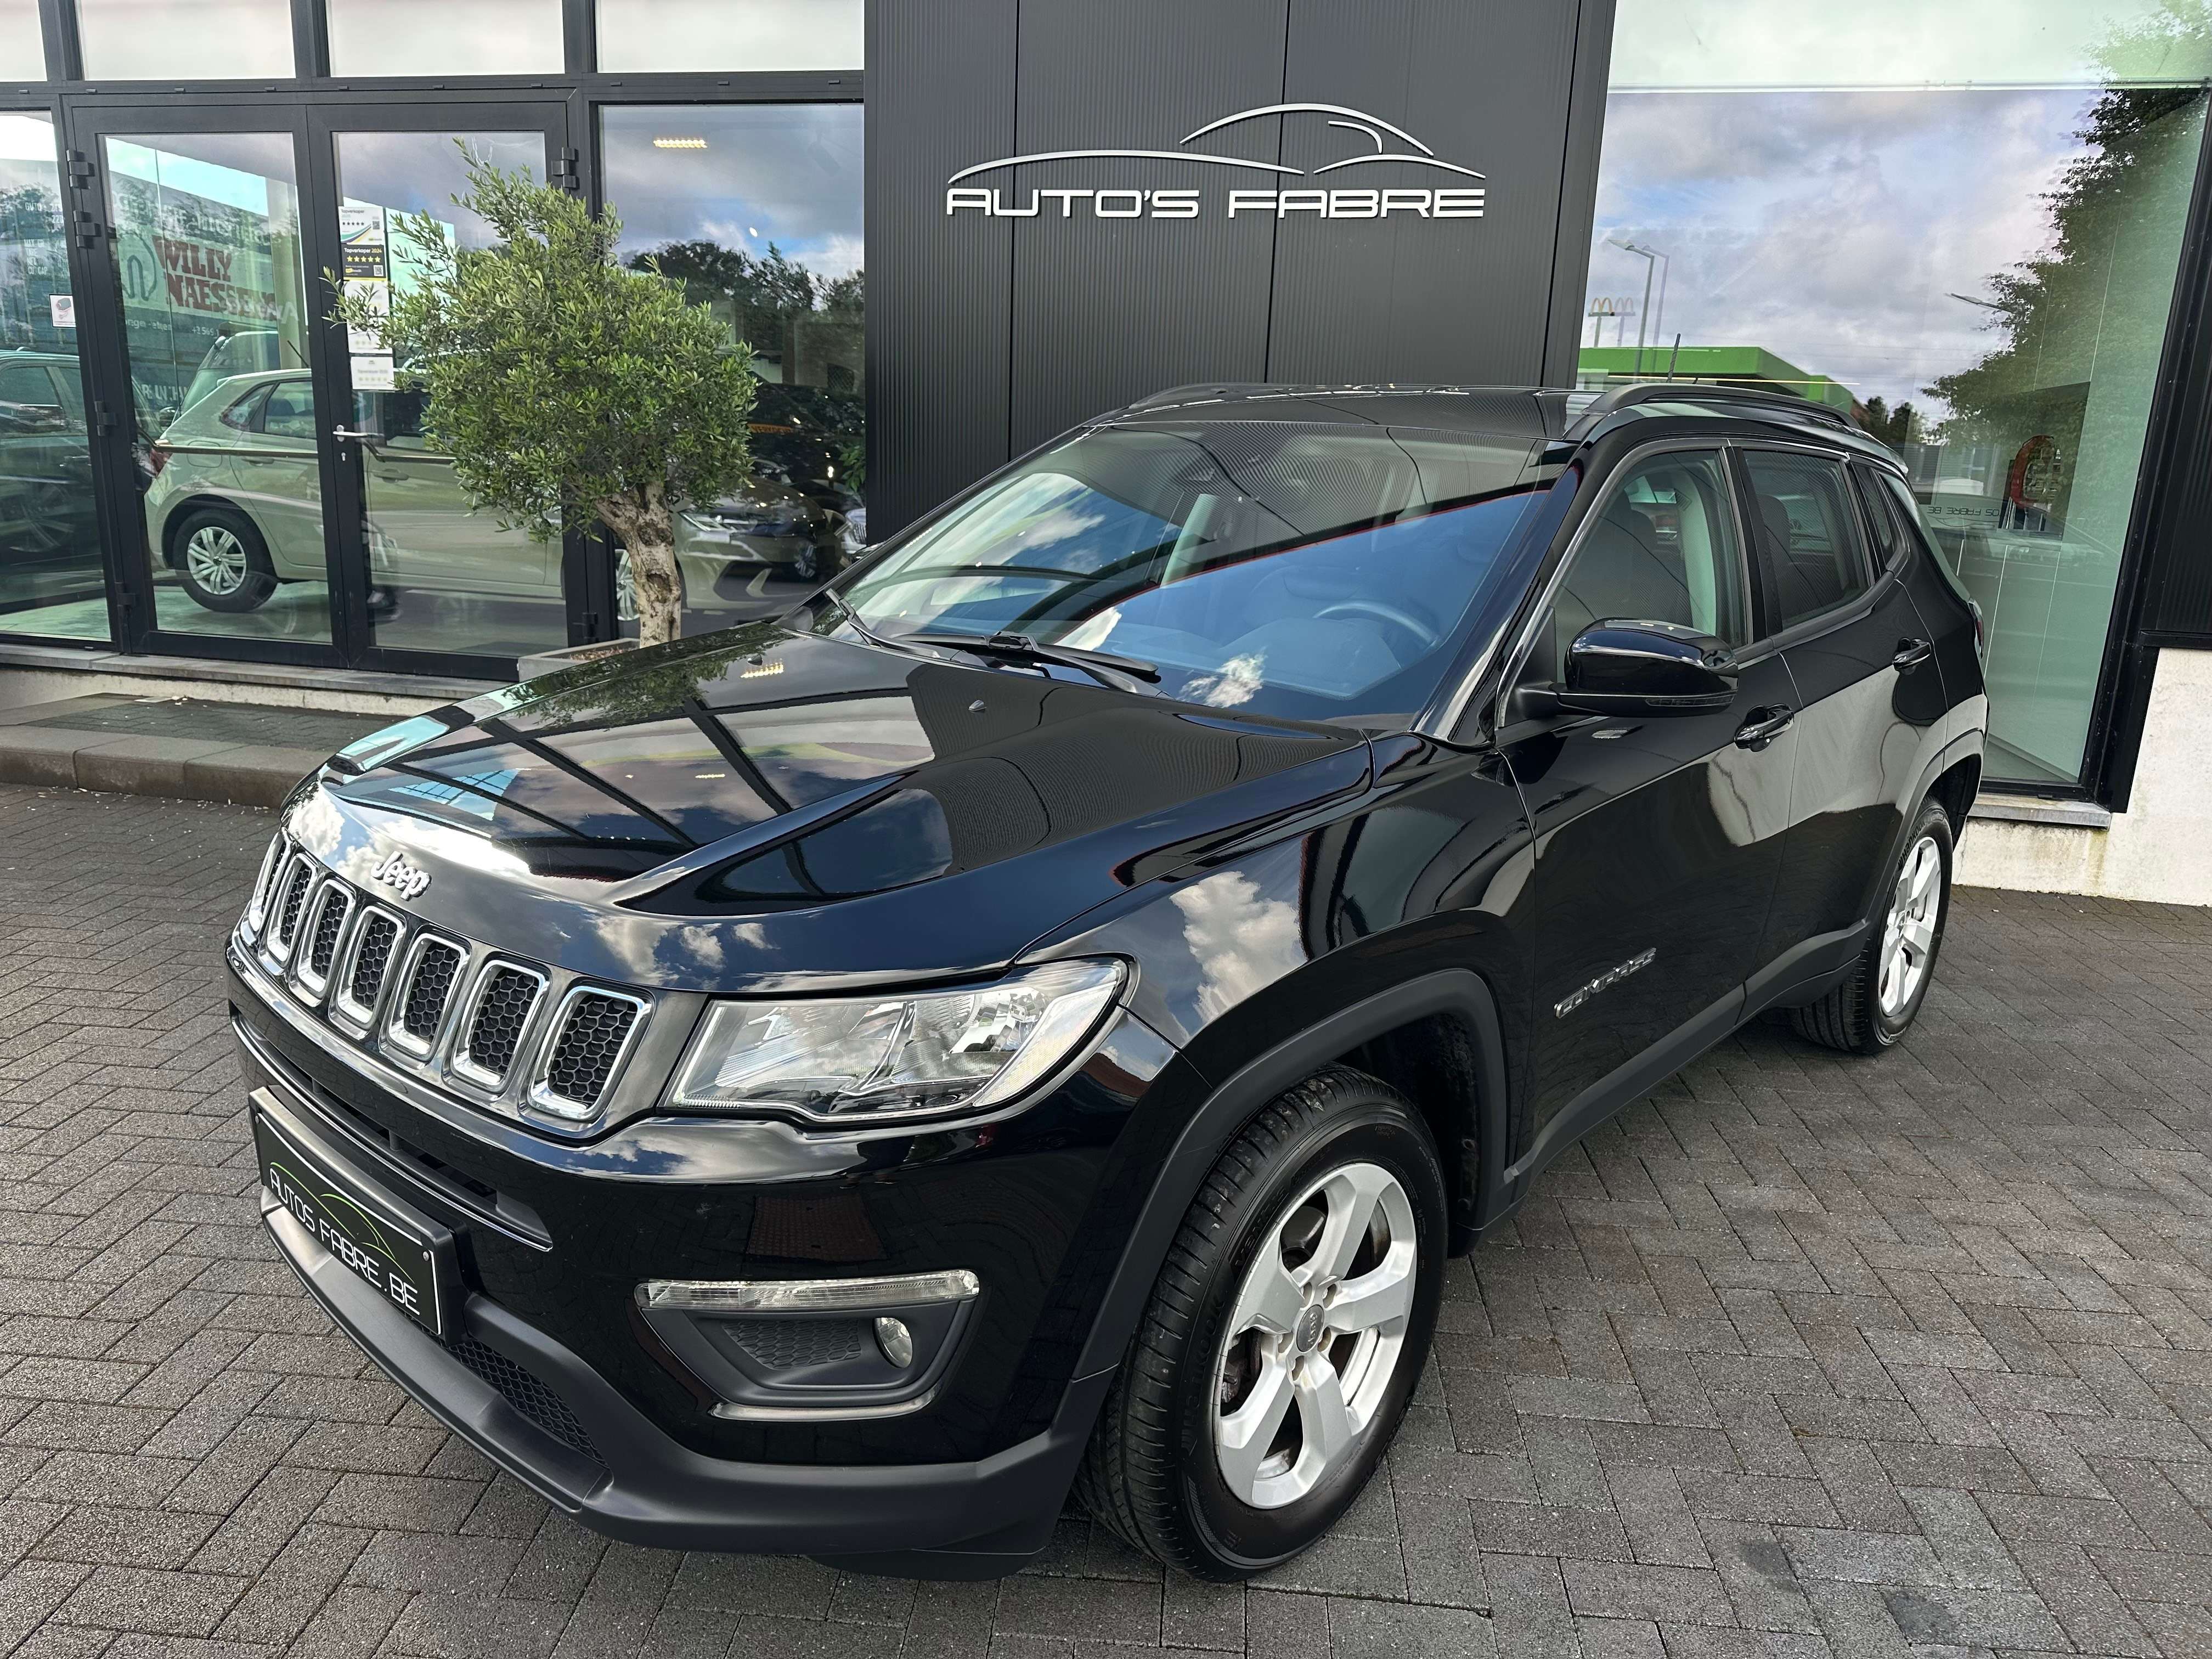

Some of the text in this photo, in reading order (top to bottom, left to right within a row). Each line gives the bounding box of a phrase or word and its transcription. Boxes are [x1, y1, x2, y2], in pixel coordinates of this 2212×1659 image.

[946, 189, 1485, 218] AUTO'S FABRE
[151, 235, 233, 282] WILLY
[371, 850, 432, 901] Jeep
[1554, 947, 1657, 1019] COMPASS
[269, 1168, 315, 1232] AUTOS
